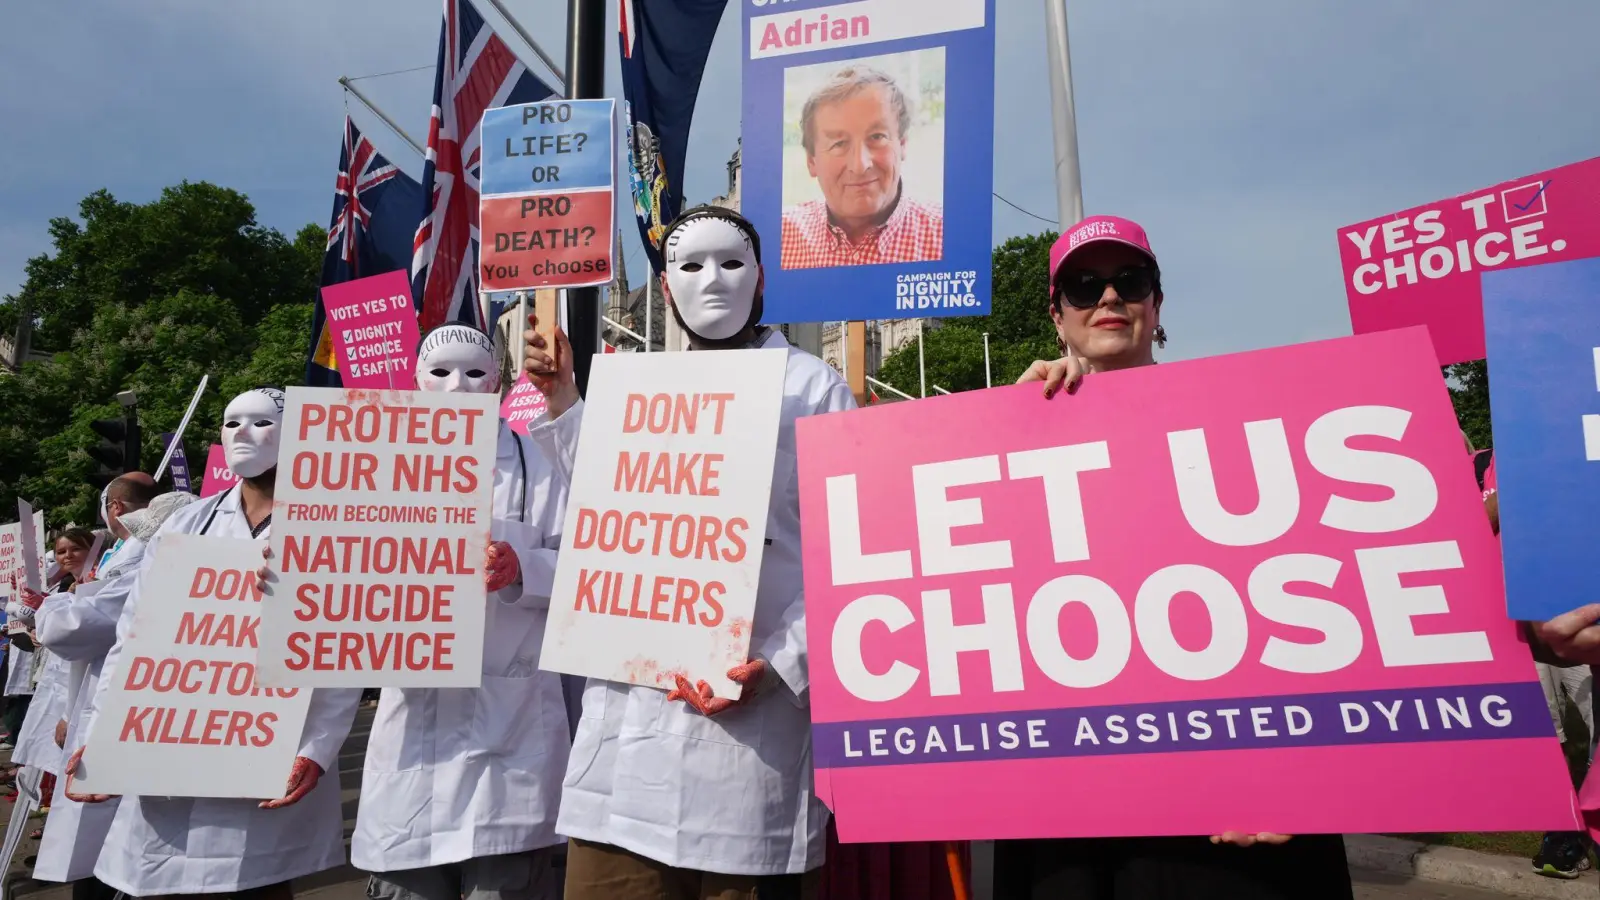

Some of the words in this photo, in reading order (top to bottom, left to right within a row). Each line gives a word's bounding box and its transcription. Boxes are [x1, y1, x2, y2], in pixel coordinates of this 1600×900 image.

[759, 13, 870, 51] Adrian
[522, 104, 572, 125] PRO
[506, 133, 588, 157] LIFE?
[532, 165, 560, 183] OR
[521, 196, 571, 218] PRO
[495, 226, 596, 253] DEATH?
[1346, 210, 1446, 260] YES
[483, 263, 518, 280] You
[533, 259, 607, 277] choose
[1352, 220, 1567, 295] CHOICE.
[896, 272, 951, 283] CAMPAIGN
[955, 271, 976, 280] FOR
[896, 280, 975, 297] DIGNITY
[330, 304, 361, 321] VOTE
[362, 299, 387, 315] YES
[389, 294, 407, 309] TO
[896, 296, 914, 310] IN
[917, 294, 981, 309] DYING.
[354, 321, 402, 341] DIGNITY
[358, 339, 402, 357] CHOICE
[299, 403, 483, 445] PROTECT
[622, 393, 735, 435] DON'T
[291, 451, 378, 491] OUR
[392, 454, 478, 493] NHS
[613, 451, 724, 496] MAKE
[287, 503, 338, 521] FROM
[344, 505, 437, 524] BECOMING
[443, 507, 476, 524] THE
[825, 440, 1111, 586] LET
[1166, 404, 1439, 546] US
[573, 508, 749, 563] DOCTORS
[281, 536, 475, 574] NATIONAL
[294, 583, 454, 622] SUICIDE
[573, 568, 727, 628] KILLERS
[174, 612, 261, 648] MAK
[831, 540, 1494, 702] CHOOSE
[284, 632, 455, 671] SERVICE
[124, 657, 299, 699] DOCTO
[119, 706, 279, 748] KILLERS
[843, 719, 1050, 758] LEGALISE
[1073, 705, 1314, 746] ASSISTED
[1342, 693, 1513, 735] DYING
